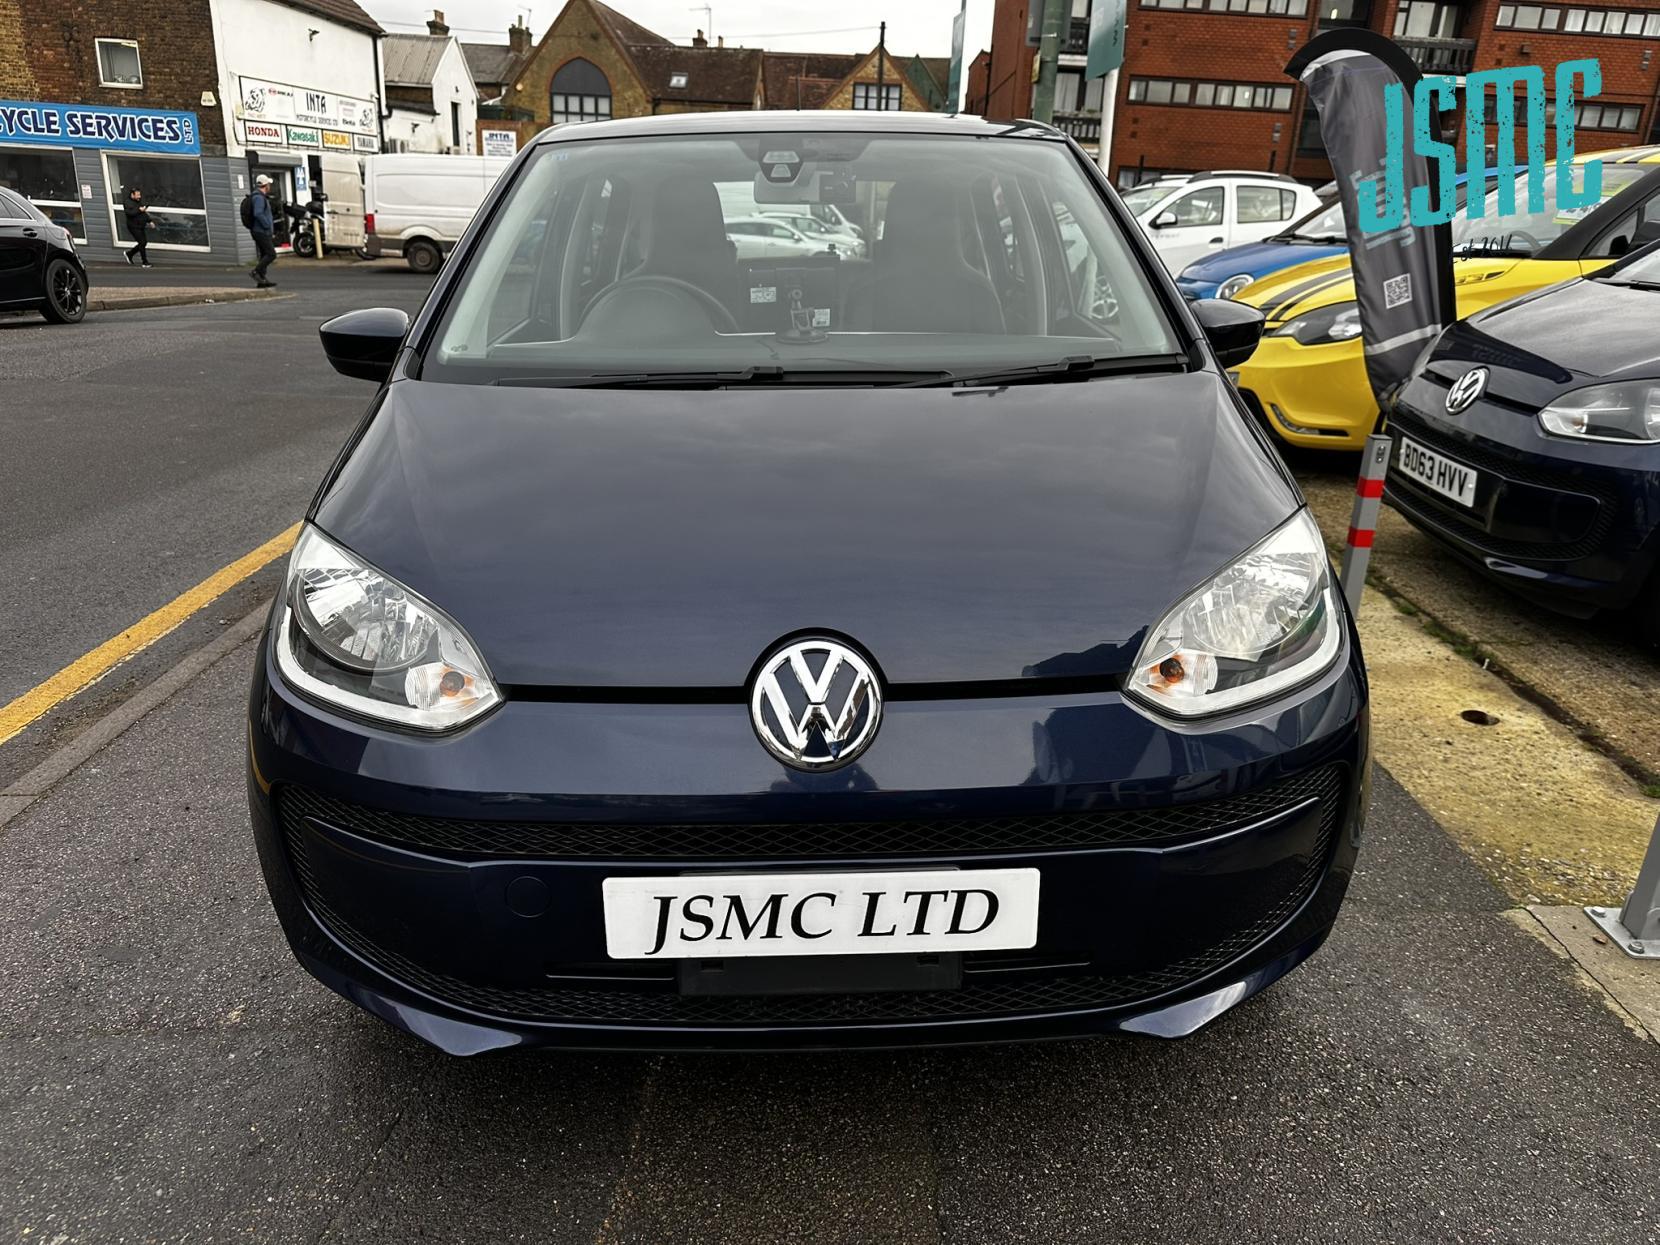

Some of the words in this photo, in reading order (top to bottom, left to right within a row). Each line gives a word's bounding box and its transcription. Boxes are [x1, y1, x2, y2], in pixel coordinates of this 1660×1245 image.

[305, 92, 327, 114] INTA
[0, 106, 62, 136] YCLE
[65, 110, 183, 143] SERVICES
[182, 119, 194, 145] LTD
[247, 126, 280, 138] HONDA
[288, 128, 319, 143] Kawasaki
[324, 132, 351, 147] SUZUKI
[1403, 443, 1435, 481] BD63
[1436, 460, 1468, 497] HVV
[644, 892, 838, 956] JSMC
[857, 888, 1001, 938] LTD
